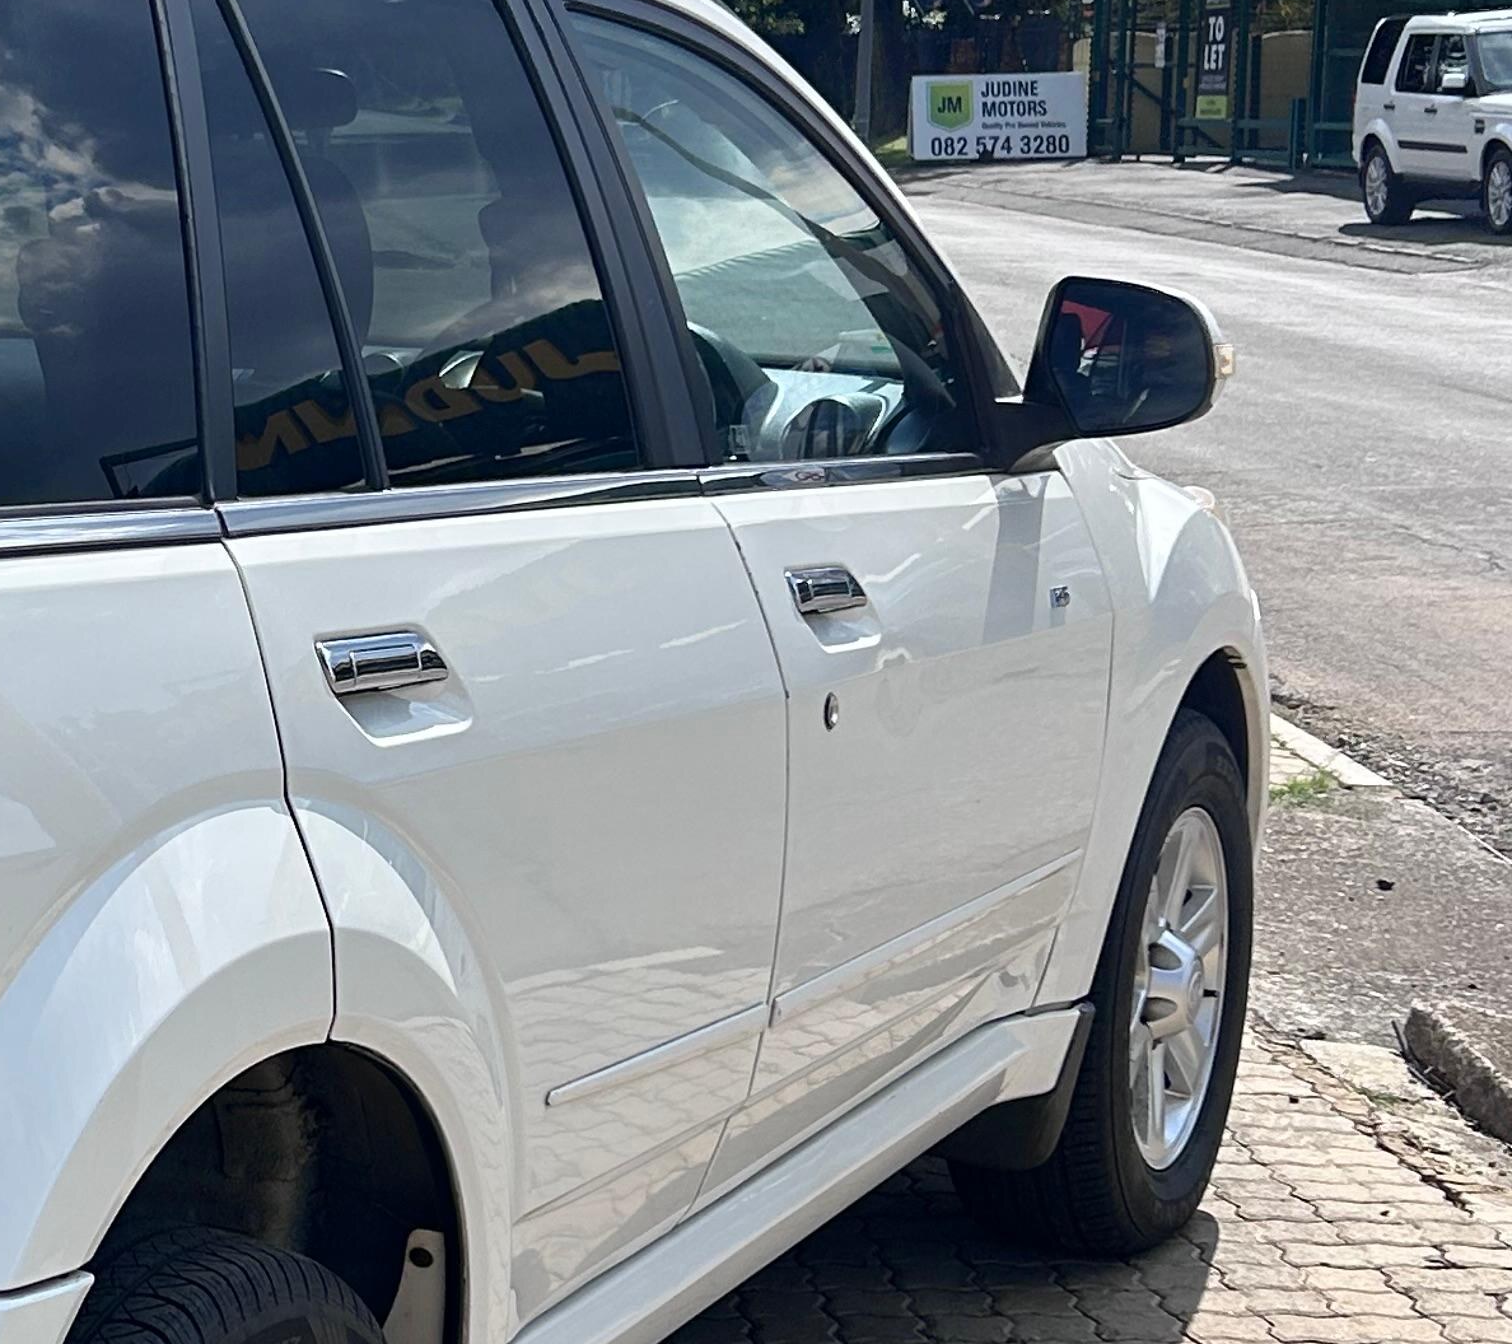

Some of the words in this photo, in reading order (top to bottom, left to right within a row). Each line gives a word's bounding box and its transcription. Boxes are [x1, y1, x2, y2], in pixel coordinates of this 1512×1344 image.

[1208, 15, 1225, 42] TO
[1203, 43, 1226, 70] LET
[980, 80, 1039, 98] JUDINE
[937, 96, 962, 114] JM
[981, 100, 1048, 117] MOTORS
[931, 137, 968, 156] 082
[976, 135, 1013, 156] 574
[1020, 134, 1070, 154] 3280
